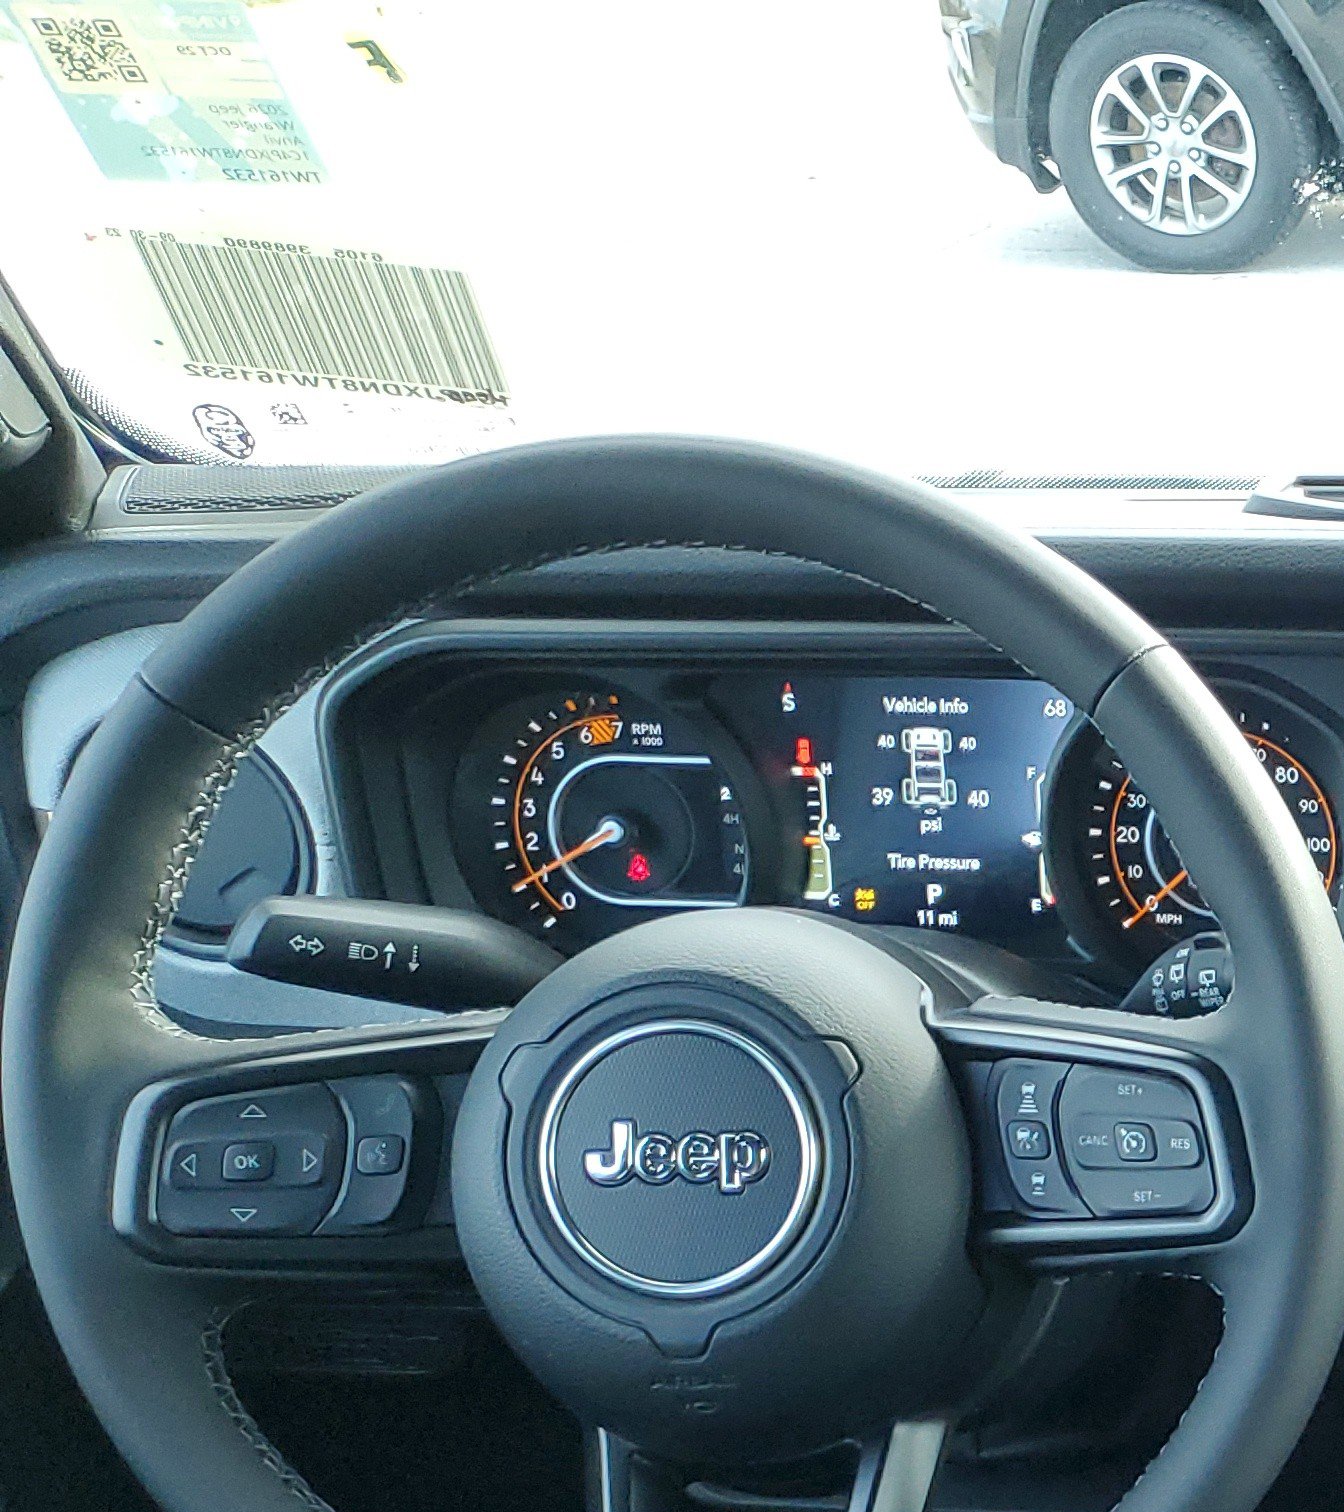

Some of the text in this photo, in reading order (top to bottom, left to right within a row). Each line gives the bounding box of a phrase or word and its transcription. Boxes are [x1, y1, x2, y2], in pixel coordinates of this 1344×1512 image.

[883, 696, 969, 714] Vehicle Info
[1043, 699, 1067, 717] 68
[580, 726, 592, 744] 6
[612, 721, 623, 740] 7
[631, 723, 662, 736] RPM
[877, 734, 895, 749] 40
[958, 736, 977, 751] 40
[551, 741, 565, 760] 5
[530, 768, 544, 785] 4
[820, 762, 832, 775] H
[1274, 767, 1299, 784] 80
[871, 787, 894, 806] 39
[967, 789, 990, 808] 40
[1127, 793, 1147, 808] 30
[523, 798, 536, 817] 3
[1299, 799, 1319, 813] 90
[920, 817, 943, 835] psi
[1116, 826, 1140, 843] 20
[526, 832, 540, 851] 2
[1306, 837, 1331, 852] 100
[886, 853, 981, 871] Tire Pressure
[1127, 864, 1143, 879] 10
[561, 892, 576, 910] 0
[828, 893, 841, 908] C
[927, 883, 943, 905] P
[916, 909, 959, 926] 11 mi
[1156, 913, 1182, 925] MPH
[1171, 1138, 1191, 1149] RES
[234, 1154, 260, 1170] OK
[583, 1117, 772, 1196] Jeep
